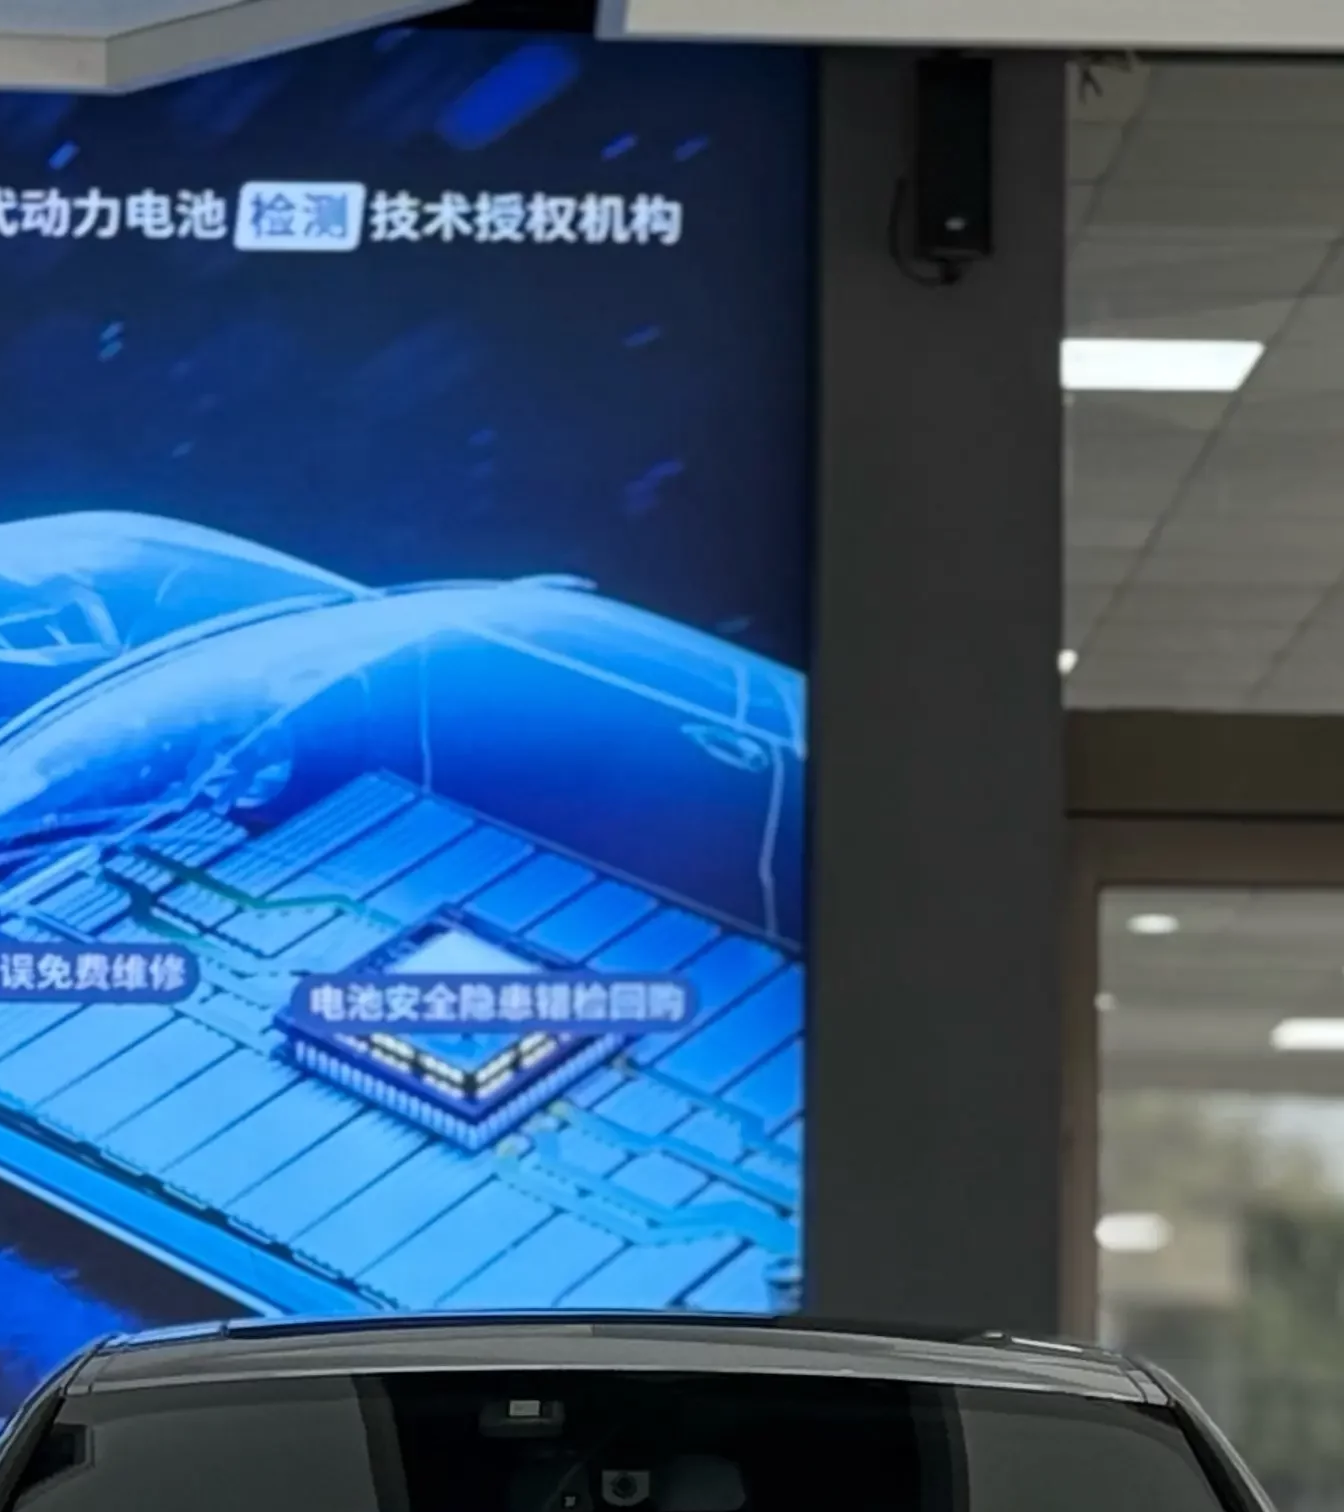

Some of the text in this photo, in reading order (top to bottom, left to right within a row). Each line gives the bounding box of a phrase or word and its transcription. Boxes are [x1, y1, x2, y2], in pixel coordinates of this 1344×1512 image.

[309, 982, 686, 1022] 电池安全隐患错检回购
